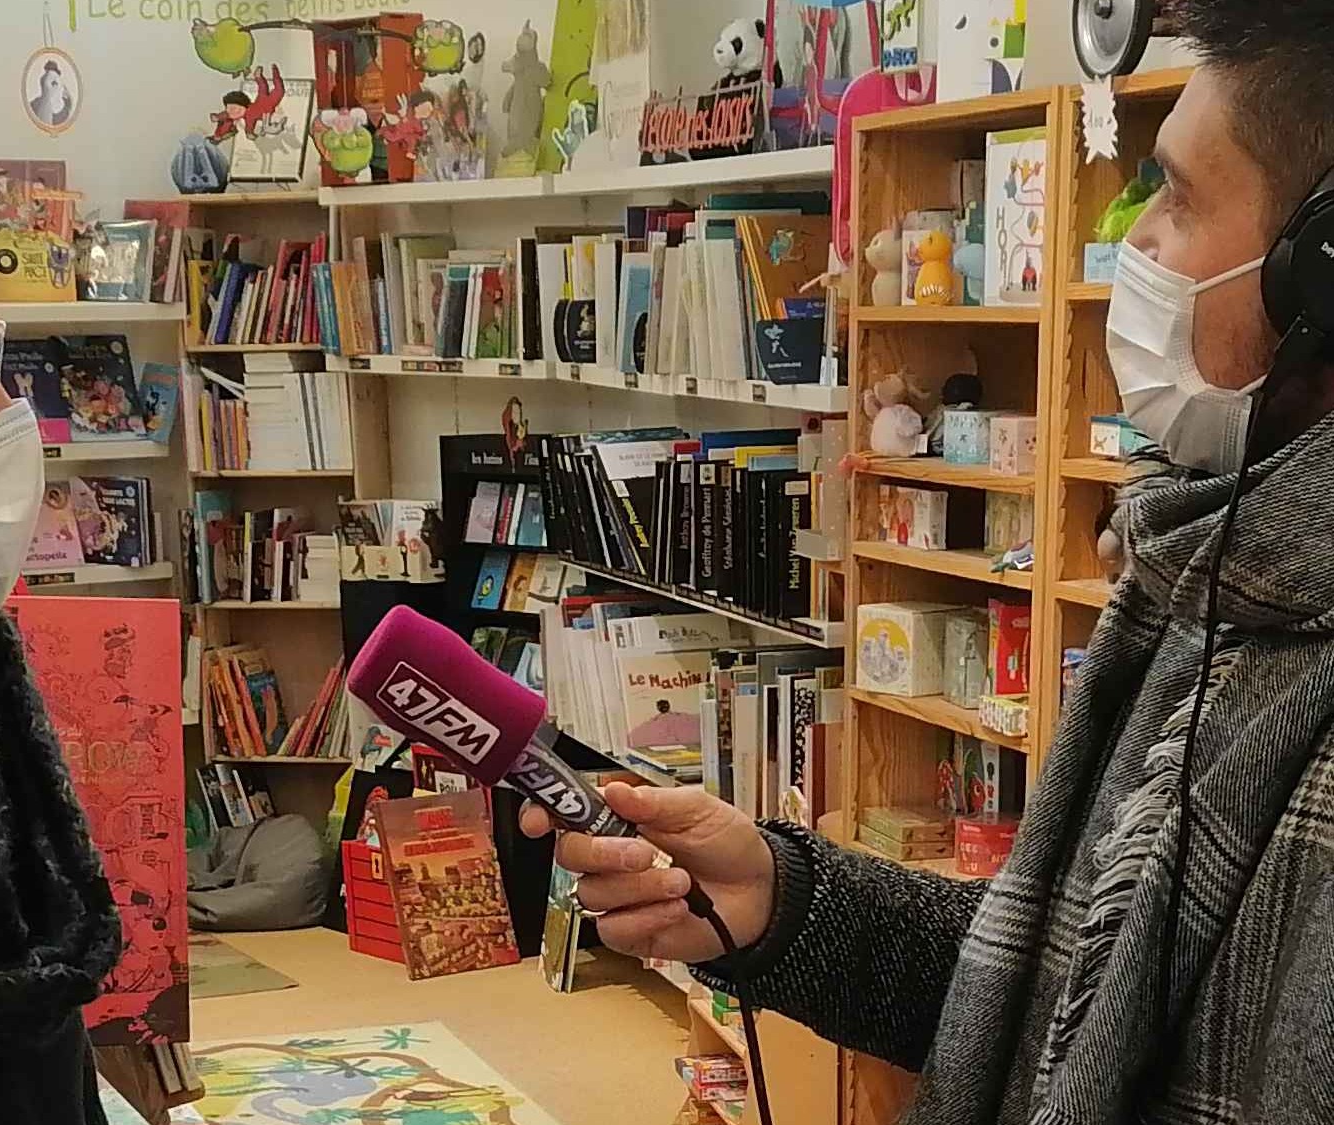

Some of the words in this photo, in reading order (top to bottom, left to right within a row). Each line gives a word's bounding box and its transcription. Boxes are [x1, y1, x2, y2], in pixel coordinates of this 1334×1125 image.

[88, 0, 130, 19] Le
[139, 1, 202, 20] coin
[212, 0, 269, 22] des
[701, 487, 712, 524] Pennart
[701, 538, 714, 578] Geoffroy
[788, 555, 800, 590] Michel
[628, 672, 646, 687] Le
